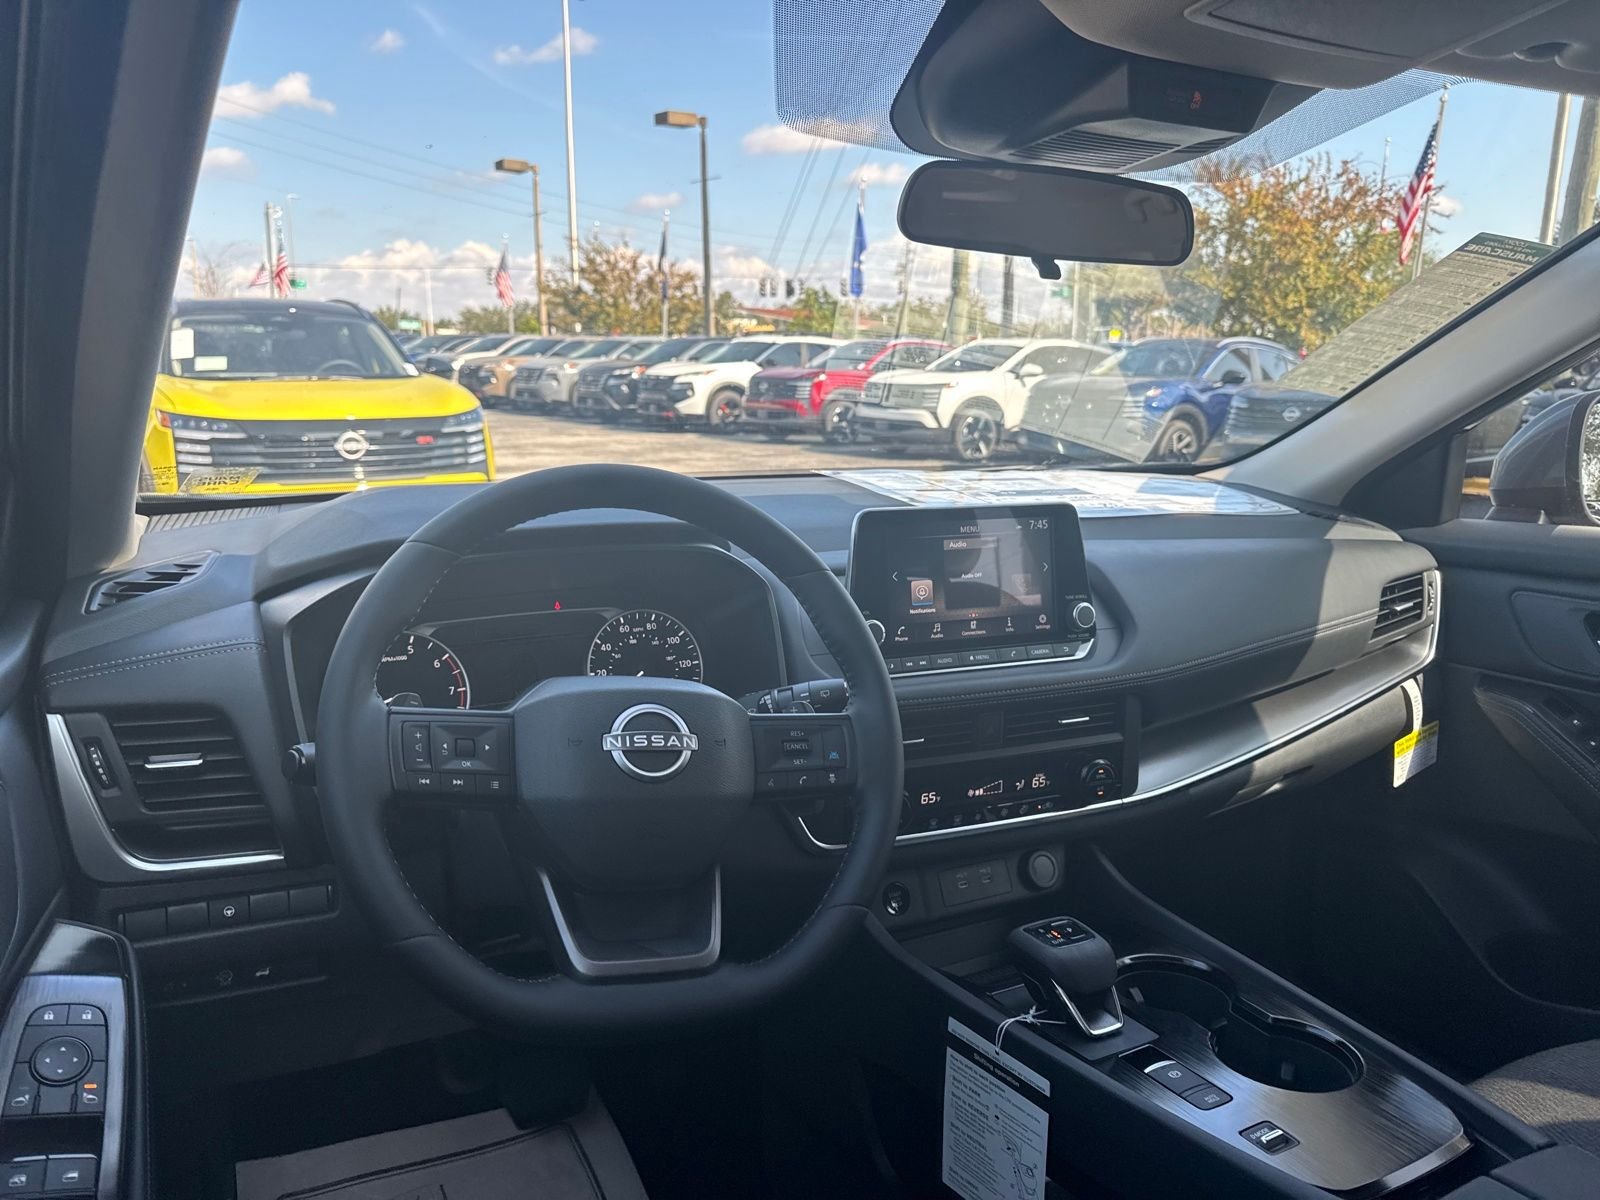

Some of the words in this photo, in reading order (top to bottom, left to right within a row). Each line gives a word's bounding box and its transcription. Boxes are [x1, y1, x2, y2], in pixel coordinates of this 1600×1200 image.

[1029, 520, 1049, 529] 7:45
[619, 625, 630, 633] 60
[646, 622, 657, 630] 80
[667, 636, 680, 644] 100
[407, 645, 414, 654] 5
[600, 643, 611, 651] 40
[433, 659, 440, 668] 6
[679, 659, 692, 667] 120
[448, 686, 455, 695] 7
[606, 735, 697, 748] NISSAN
[461, 760, 472, 768] OK
